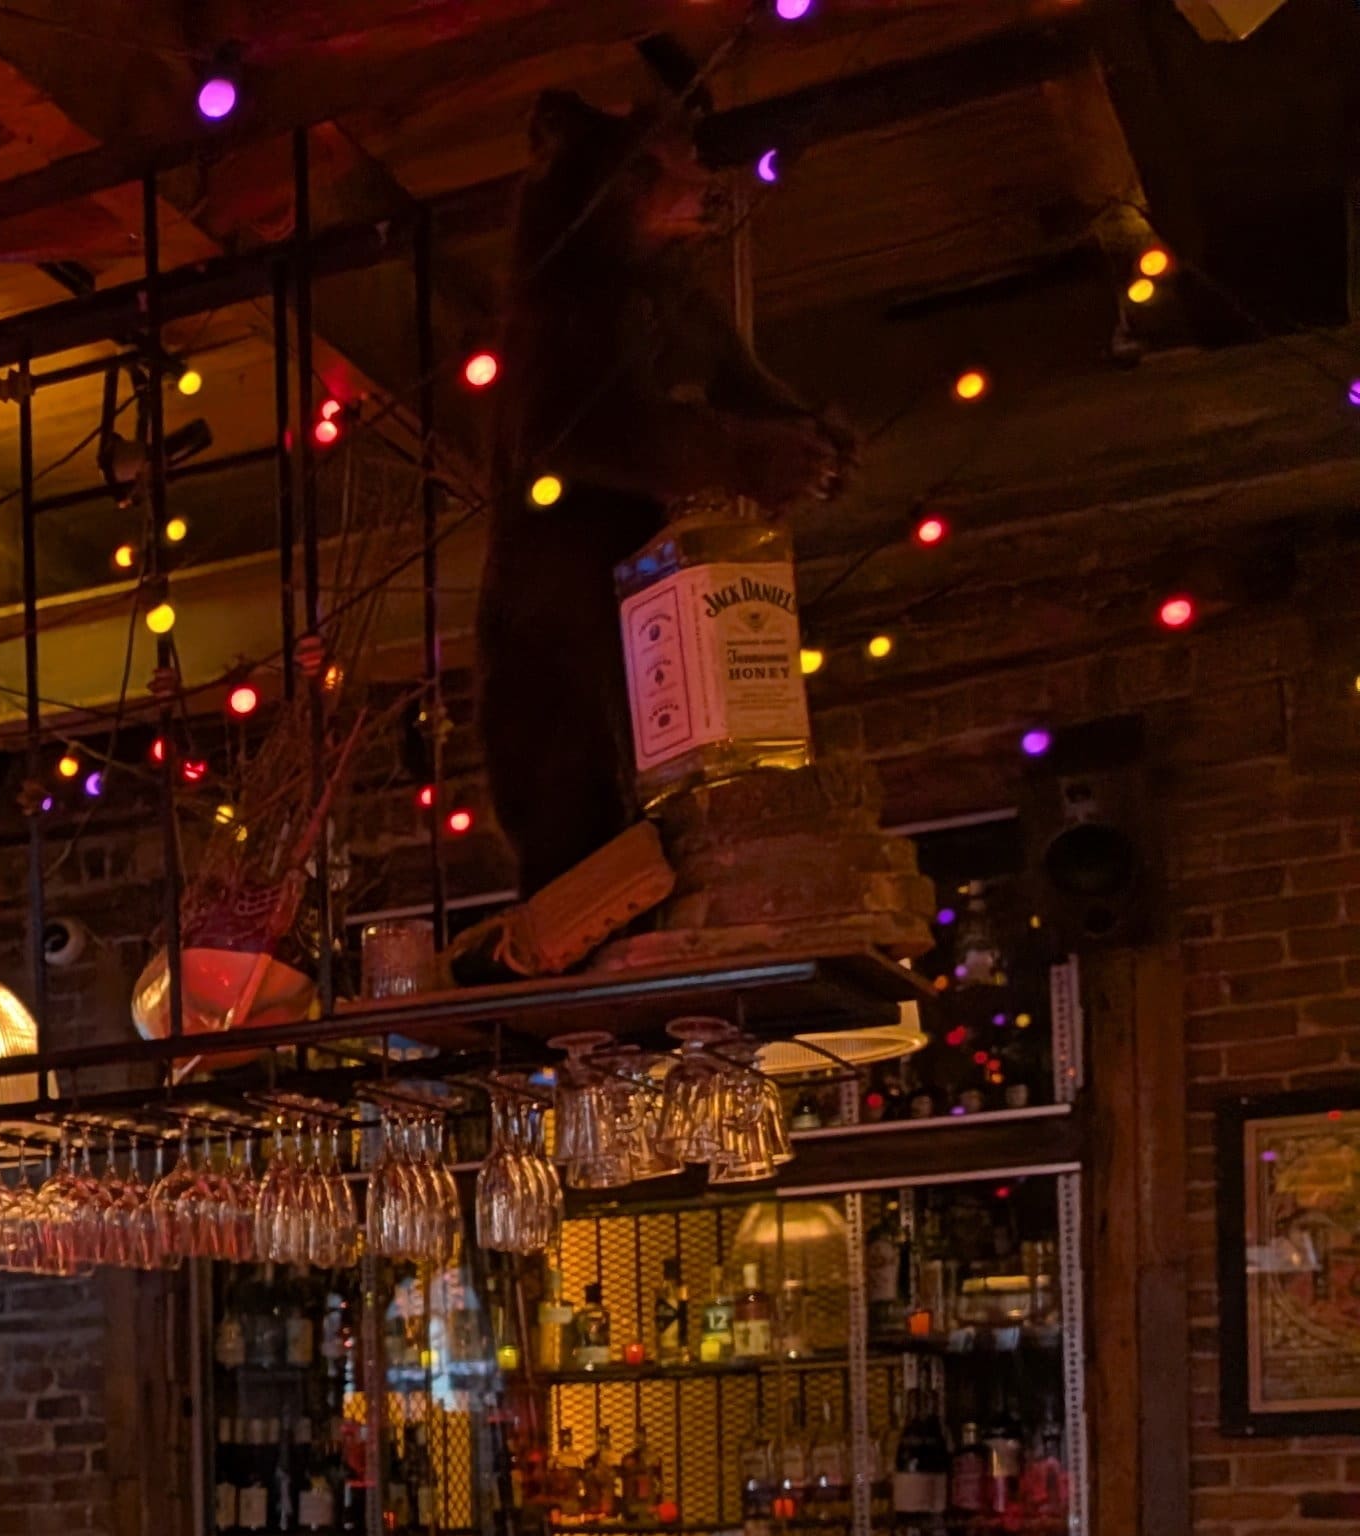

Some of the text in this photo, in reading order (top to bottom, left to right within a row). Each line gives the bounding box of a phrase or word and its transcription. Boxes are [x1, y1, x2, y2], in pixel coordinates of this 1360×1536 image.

[702, 576, 797, 617] JACK DANIEL
[728, 667, 790, 680] HONEY
[707, 1309, 729, 1330] 12
